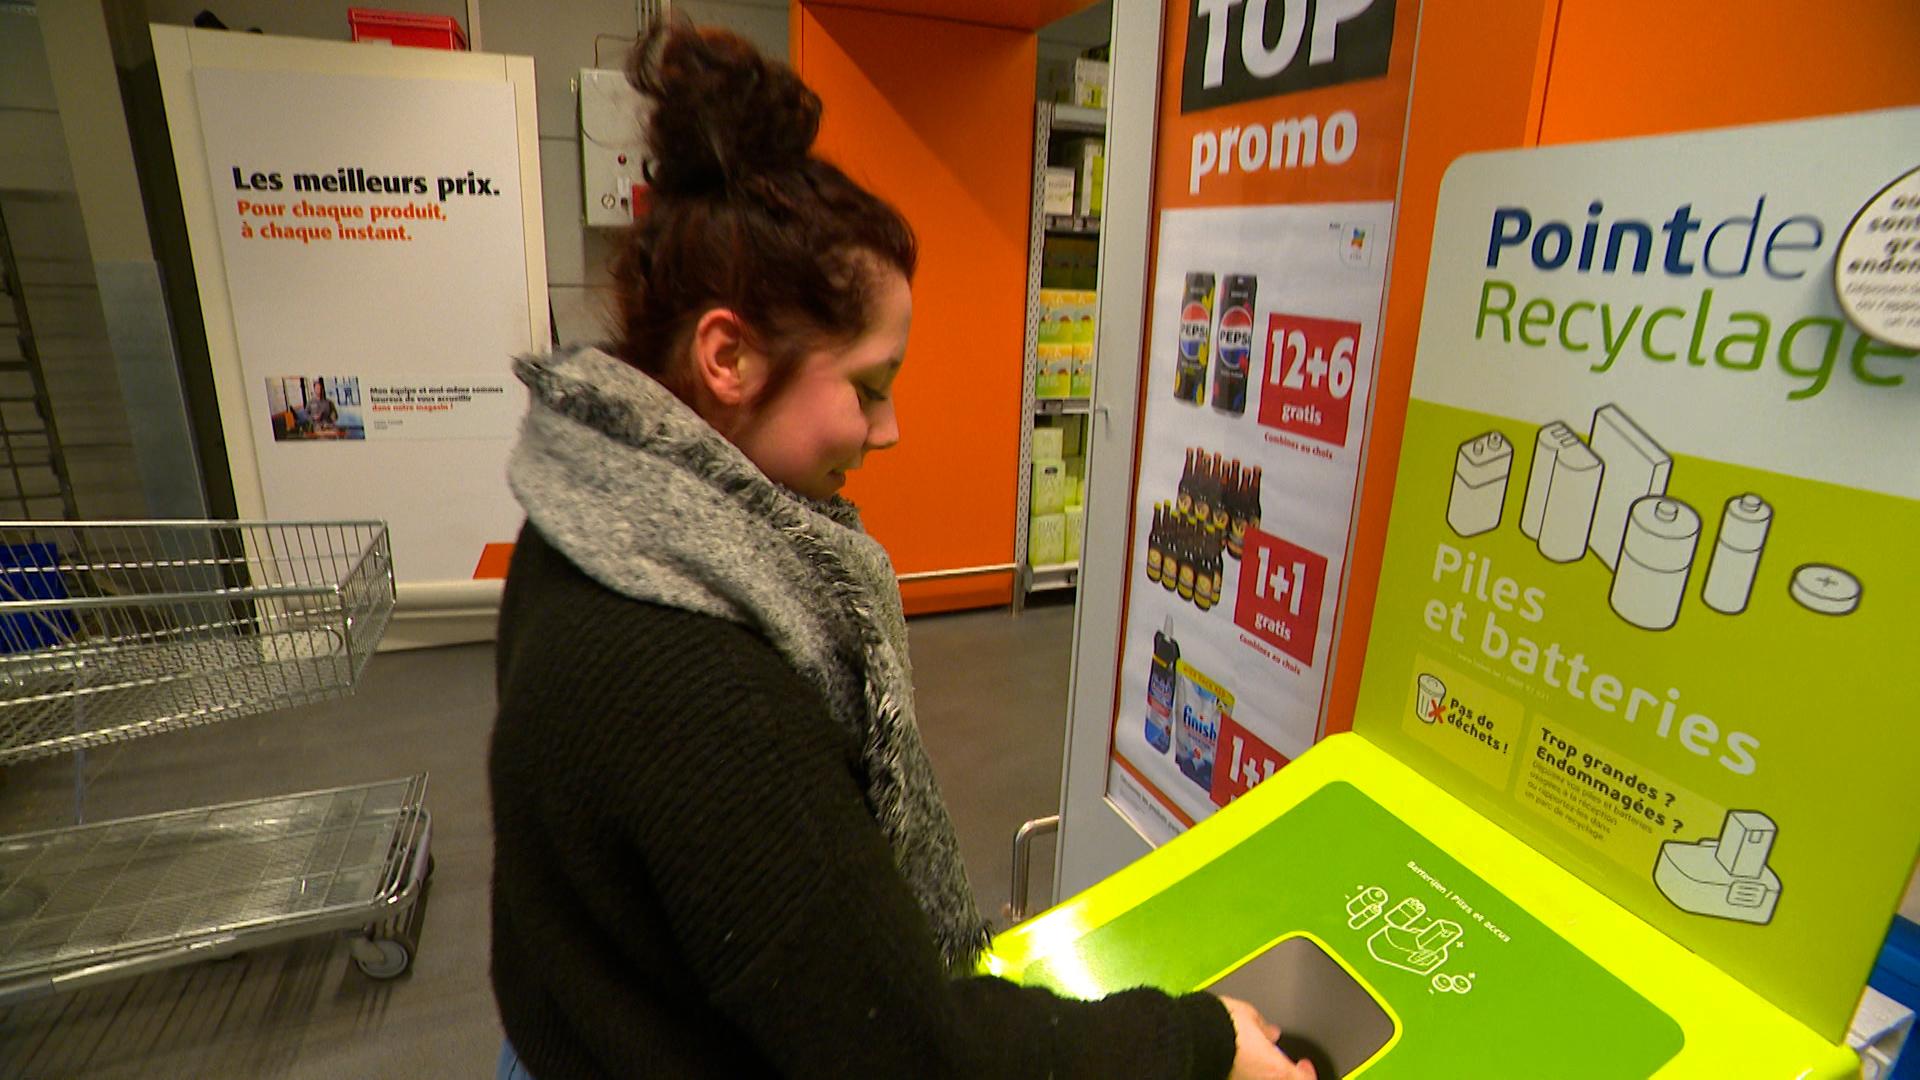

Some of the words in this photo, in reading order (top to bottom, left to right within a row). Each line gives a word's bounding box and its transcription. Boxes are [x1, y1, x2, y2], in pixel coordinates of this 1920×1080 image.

[1198, 0, 1373, 89] TOP
[1189, 109, 1358, 195] promo
[232, 166, 283, 191] Les
[293, 167, 428, 194] meilleurs
[437, 171, 500, 201] prix.
[237, 199, 285, 217] Pour
[292, 200, 363, 223] chaque
[370, 202, 447, 223] produit,
[241, 221, 253, 239] à
[260, 222, 332, 244] chaque
[337, 224, 412, 241] instant.
[1269, 328, 1355, 400] 12+6
[372, 403, 391, 412] dans
[393, 403, 414, 412] notre
[405, 394, 415, 402] de
[419, 386, 427, 394] et
[1282, 404, 1322, 426] gratis
[1313, 446, 1333, 460] choix
[1256, 546, 1306, 617] 1+1
[1432, 543, 1546, 623] Piles
[1255, 612, 1291, 641] gratis
[1424, 599, 1468, 644] et
[1481, 613, 1761, 777] batteries
[1184, 704, 1217, 741] finish
[1450, 698, 1473, 719] Pas
[1477, 715, 1494, 730] de
[1541, 727, 1577, 758] Trop
[1583, 752, 1659, 801] grandes
[1536, 745, 1666, 826] Endommagées
